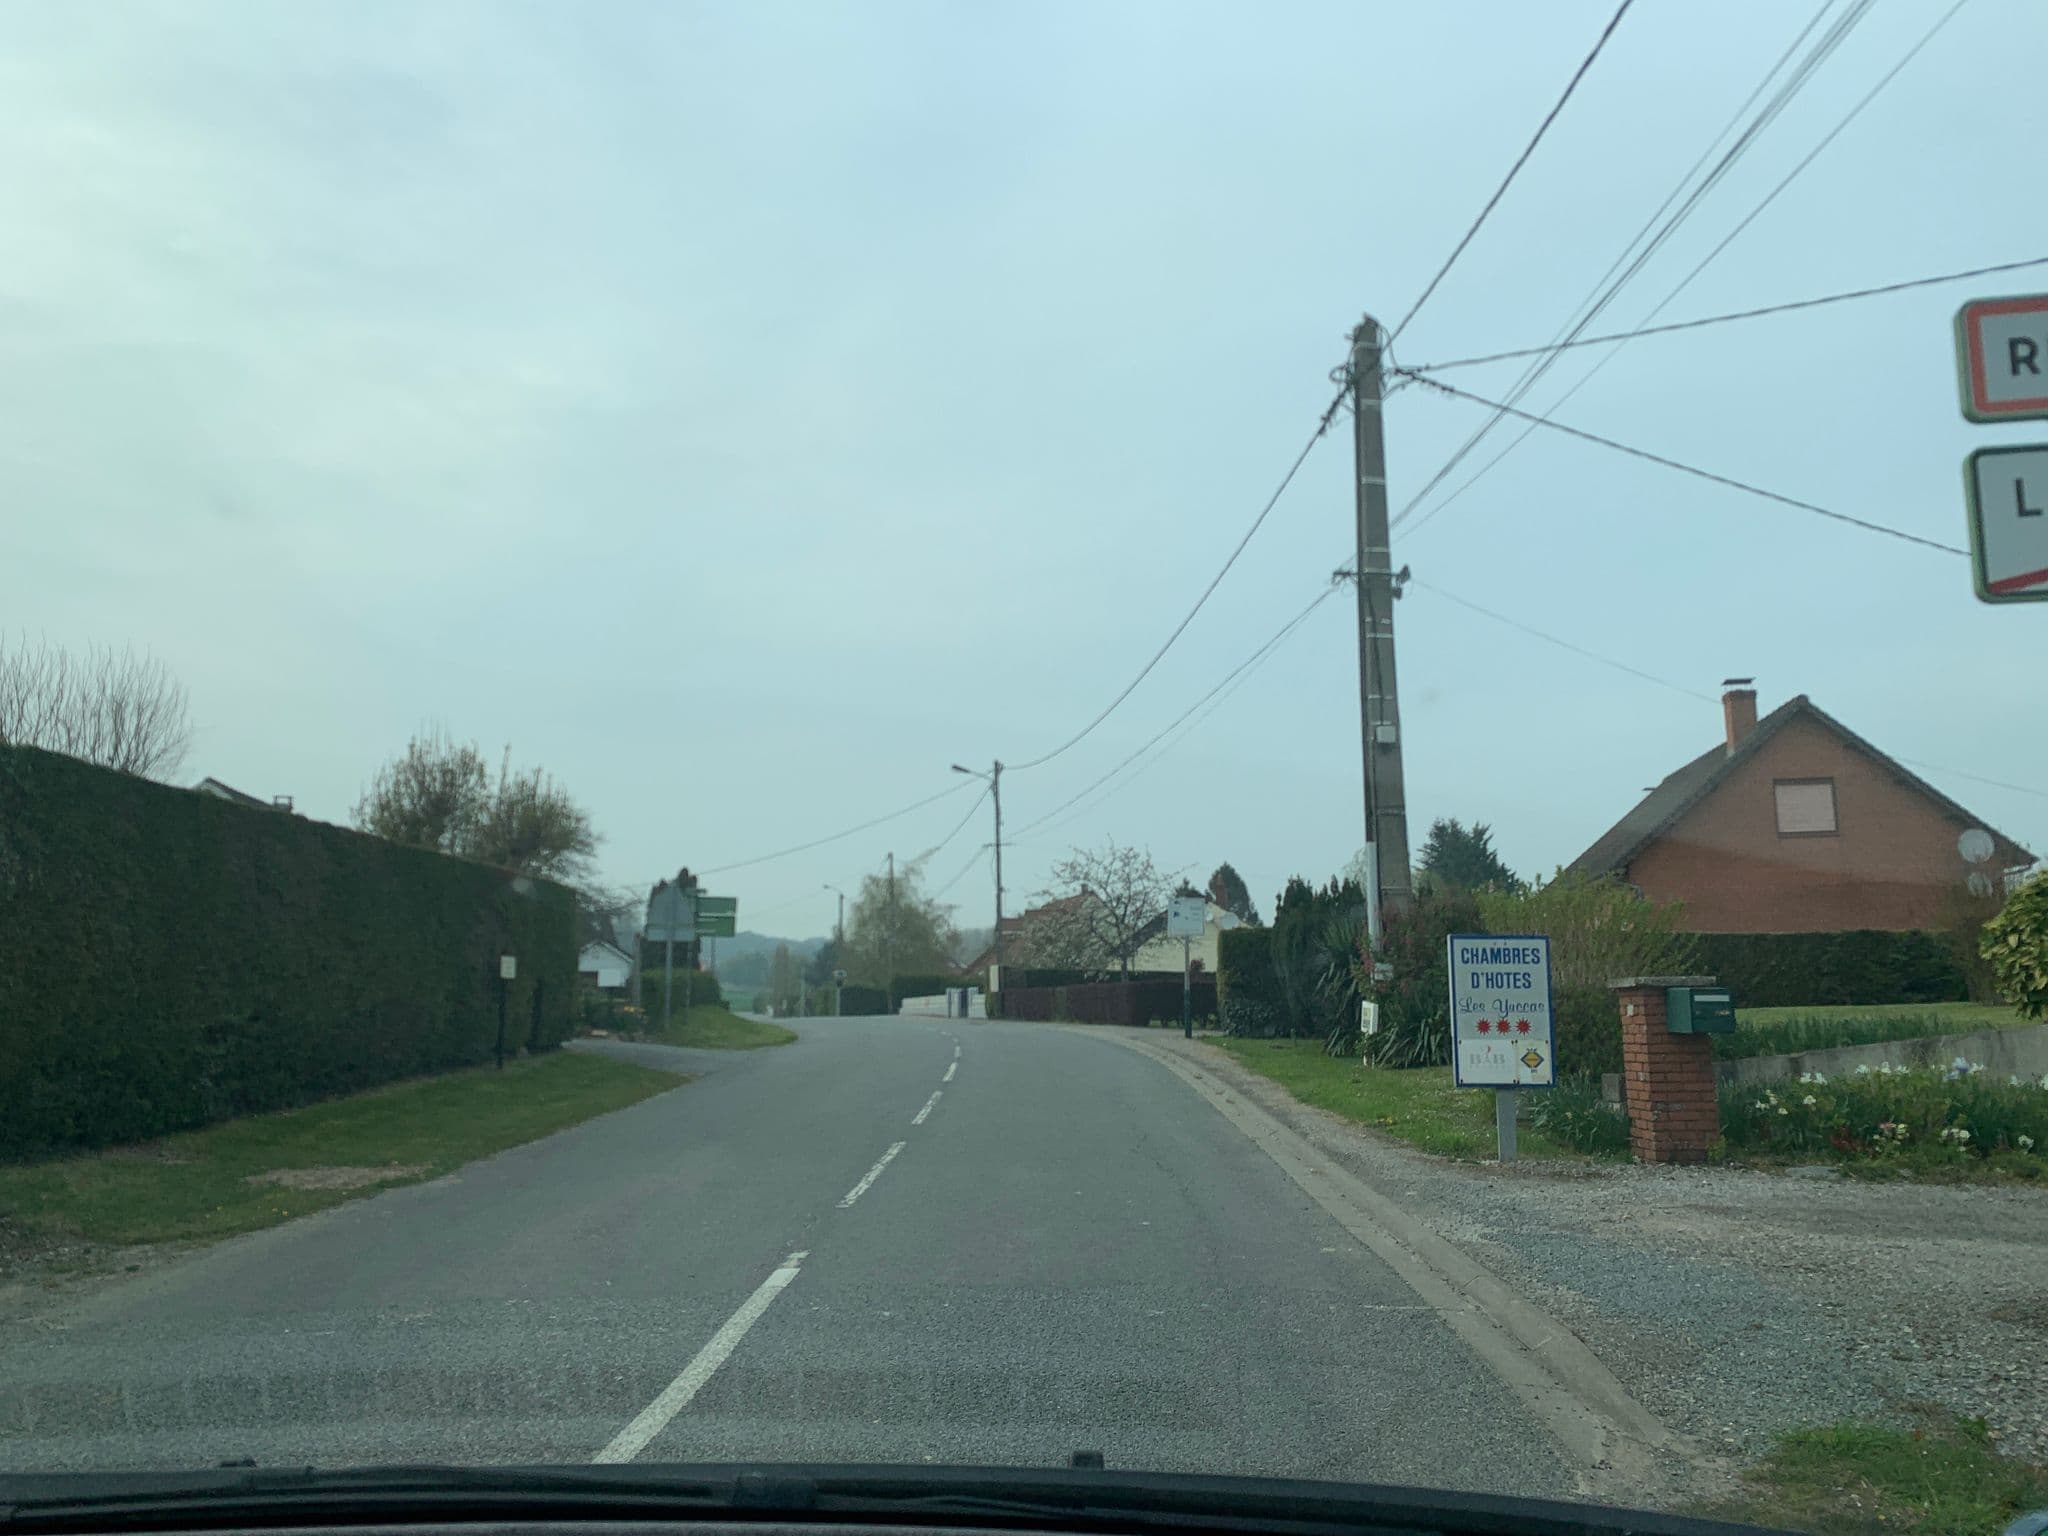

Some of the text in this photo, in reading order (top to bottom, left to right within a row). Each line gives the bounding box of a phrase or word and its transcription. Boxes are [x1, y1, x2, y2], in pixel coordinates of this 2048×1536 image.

[2008, 335, 2048, 377] R
[1461, 947, 1541, 965] CHAMBRES
[1471, 971, 1532, 990] D'HOTES
[1458, 996, 1545, 1018] Les Yuccas
